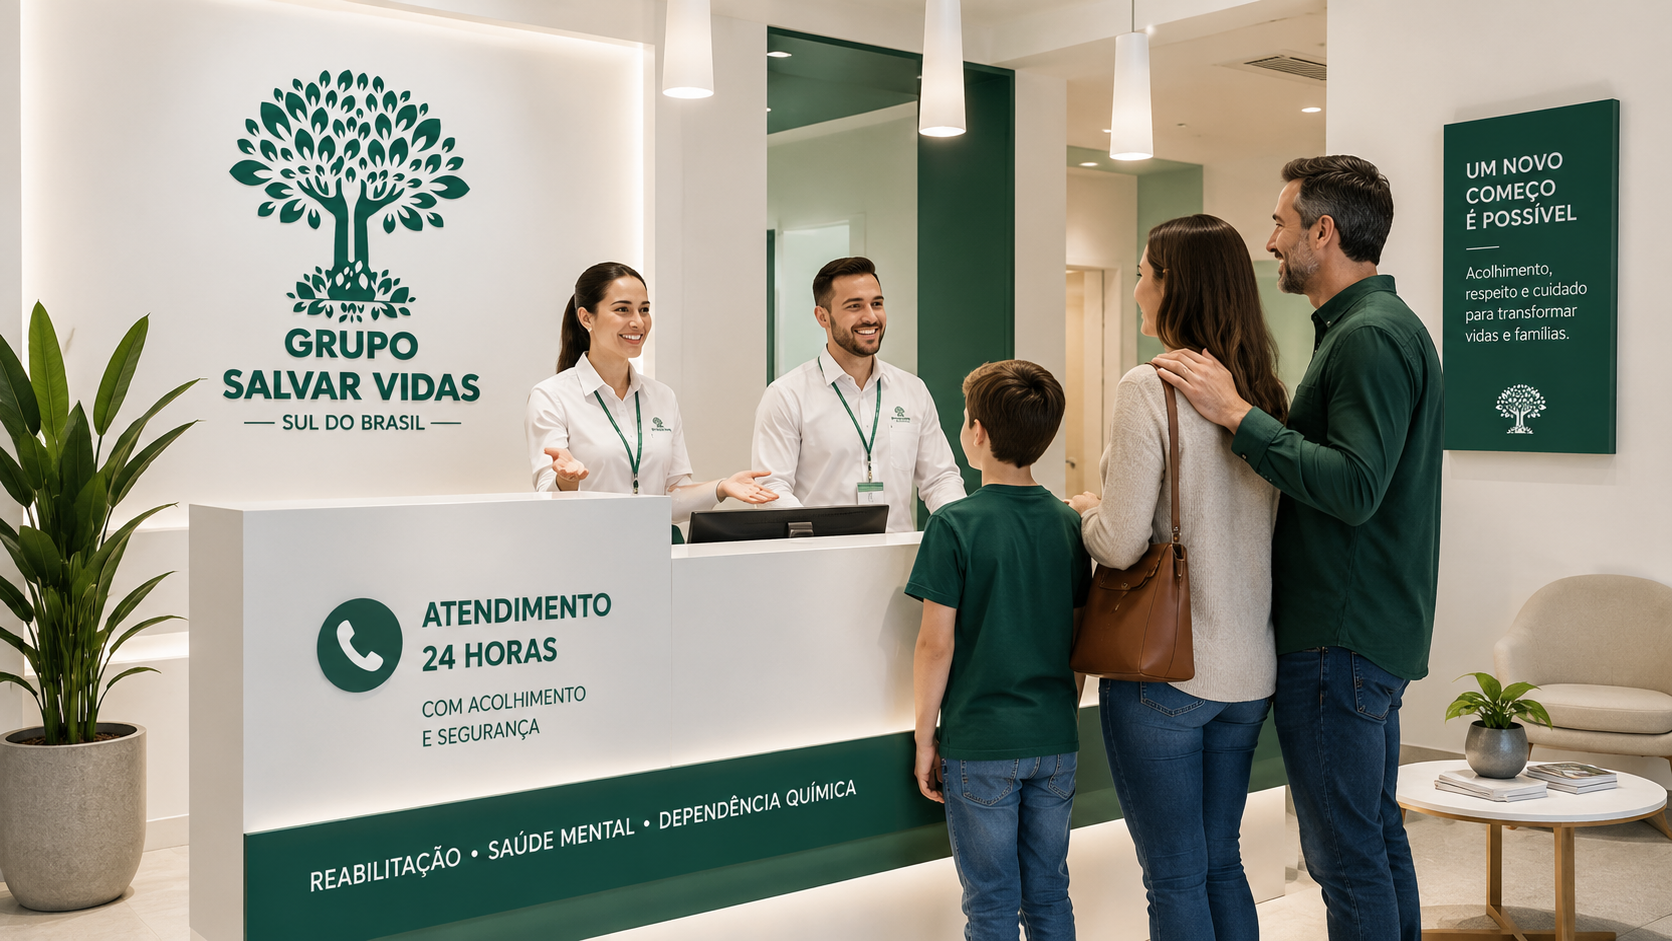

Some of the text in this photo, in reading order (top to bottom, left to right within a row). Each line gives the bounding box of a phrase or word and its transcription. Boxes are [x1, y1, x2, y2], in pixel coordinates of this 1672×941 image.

[1467, 152, 1563, 178] UM NOVO
[1466, 179, 1556, 204] COMEÇO
[1466, 203, 1577, 230] É POSSÍVEL
[1465, 263, 1553, 280] Acolhimento,
[1465, 281, 1588, 302] respeito e cuidado
[1465, 305, 1578, 324] para transformar
[284, 328, 418, 360] GRUPO
[1465, 329, 1499, 343] vidas
[1502, 331, 1511, 342] e
[222, 369, 480, 402] SALVAR VIDAS
[282, 415, 425, 430] SUL DO BRASIL
[421, 593, 611, 627] ATENDIMENTO
[422, 637, 558, 671] 24 HORAS
[422, 685, 587, 718] COM ACOLHIMENTO
[422, 718, 540, 747] E SEGURANÇA
[310, 780, 857, 892] REABILITAÇÃO SAÚDE MENTAL DEPENDÊNCIA QUÍMICA
